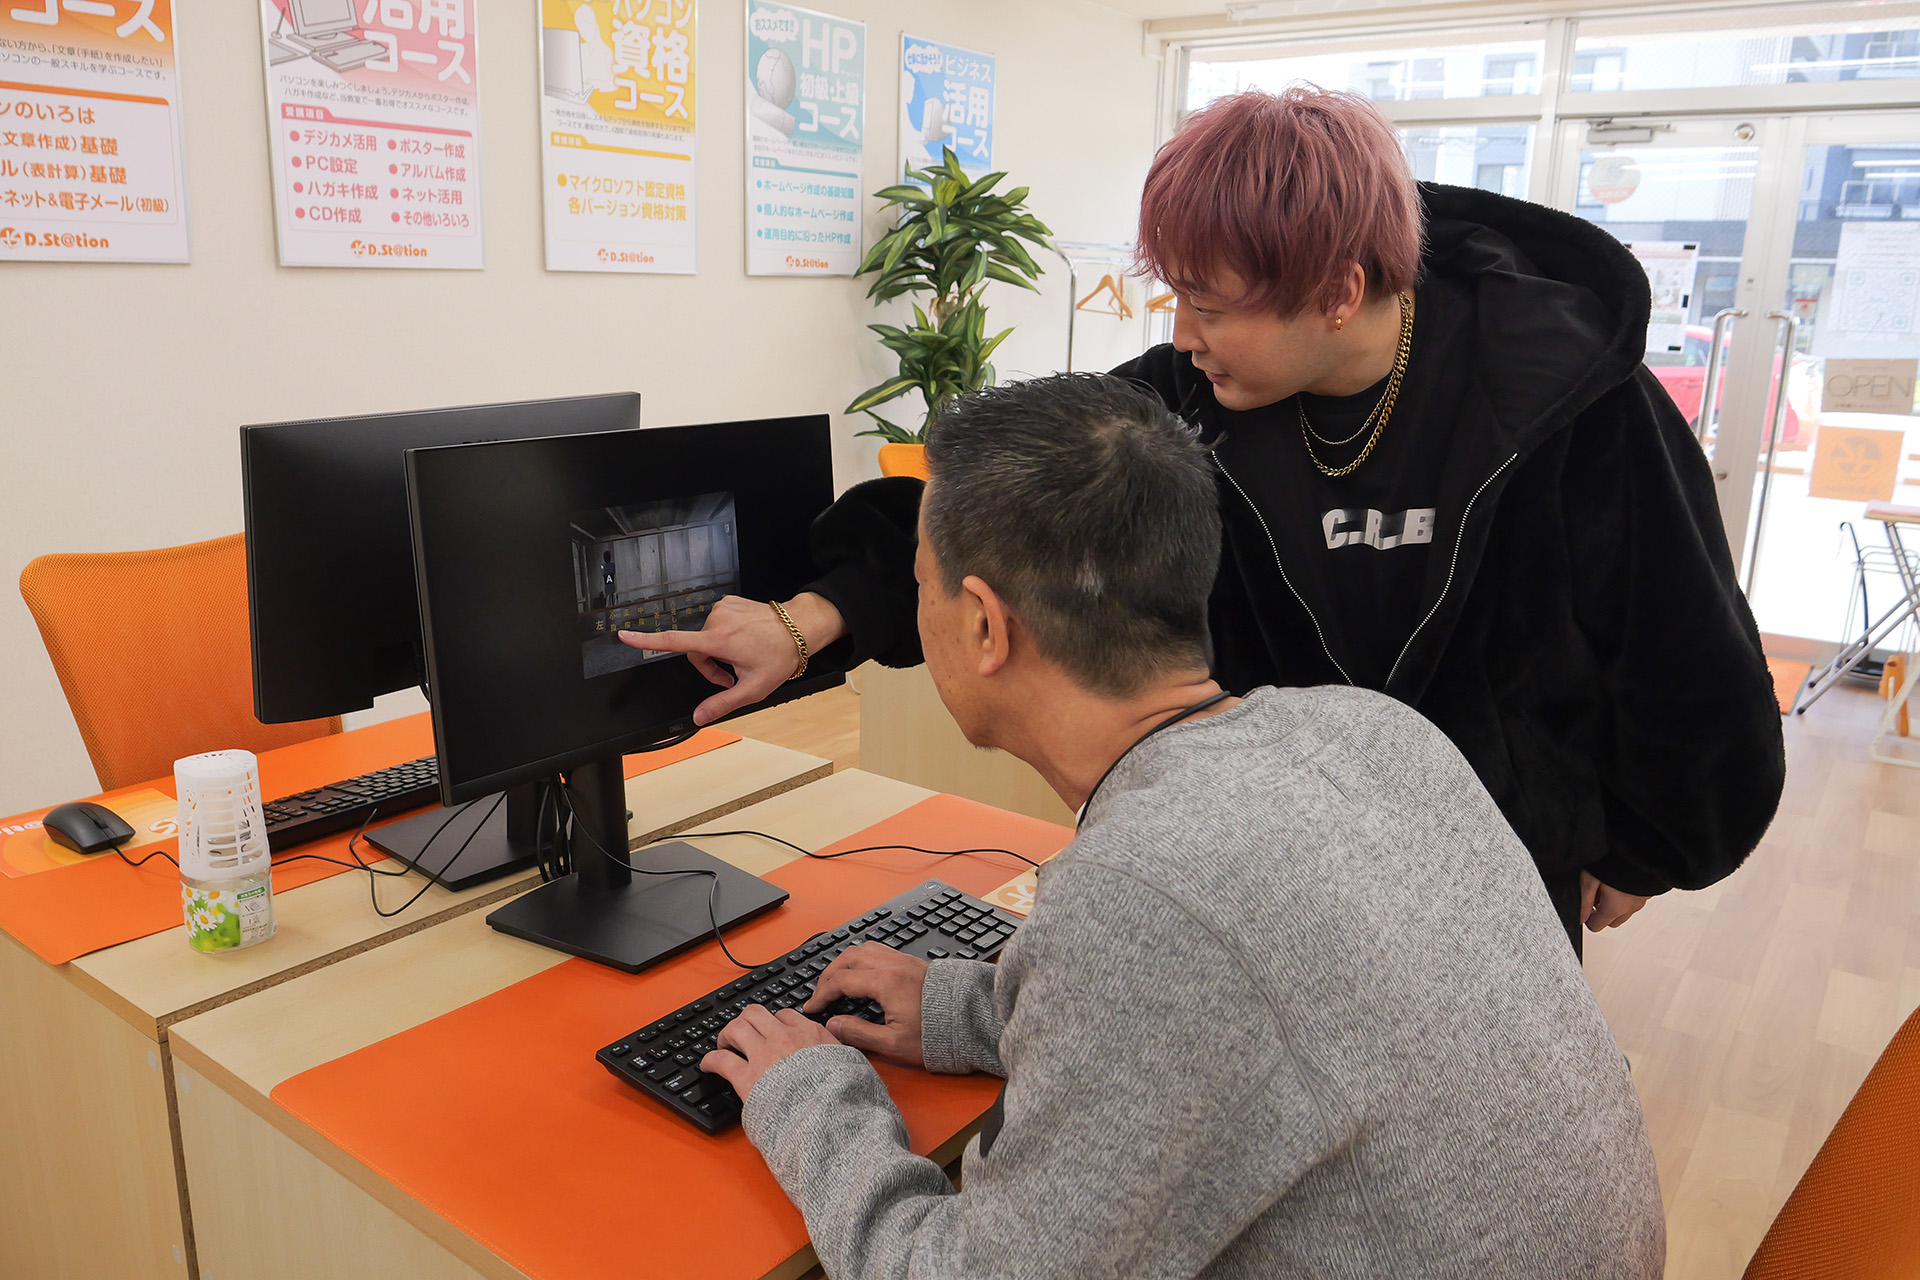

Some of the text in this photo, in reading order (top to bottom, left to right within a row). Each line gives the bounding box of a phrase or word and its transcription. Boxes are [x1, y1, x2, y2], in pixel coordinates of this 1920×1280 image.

[364, 30, 471, 84] コース
[612, 18, 689, 84] 資格
[802, 19, 857, 74] HP
[0, 52, 166, 80] ソコンの一般スキルを学ぶコースです。
[945, 55, 992, 83] ビジネス
[615, 77, 688, 119] コース
[800, 72, 859, 106] 初級・上級
[942, 79, 989, 128] 活用
[799, 101, 859, 139] コース
[0, 131, 119, 156] 文章作成）基礎
[304, 130, 377, 151] デジカメ活用
[400, 139, 465, 159] ポスター作成
[941, 124, 989, 158] コース
[306, 155, 358, 174] PC設定
[401, 163, 466, 182] アルバム作成
[307, 182, 378, 200] ハガキ作成
[402, 188, 463, 205] ネット活用
[569, 174, 685, 200] マイクロソフト認定資格
[764, 180, 854, 199] ホームページ作成の基礎知識
[0, 190, 169, 212] ネット&電子メール（初級）
[568, 196, 686, 221] 各バージョン資格対策
[309, 206, 362, 224] CD作成
[403, 211, 470, 227] その他いろいろ
[764, 203, 854, 222] 個人的なホームページ作成
[25, 232, 109, 248] D.St@tion
[764, 228, 851, 244] 運用目的に沿ったHP作成
[368, 244, 427, 257] D.St@tion
[610, 252, 654, 264] D.St@tion
[1827, 374, 1912, 398] OPEN
[606, 574, 613, 583] A
[595, 620, 604, 631] 左
